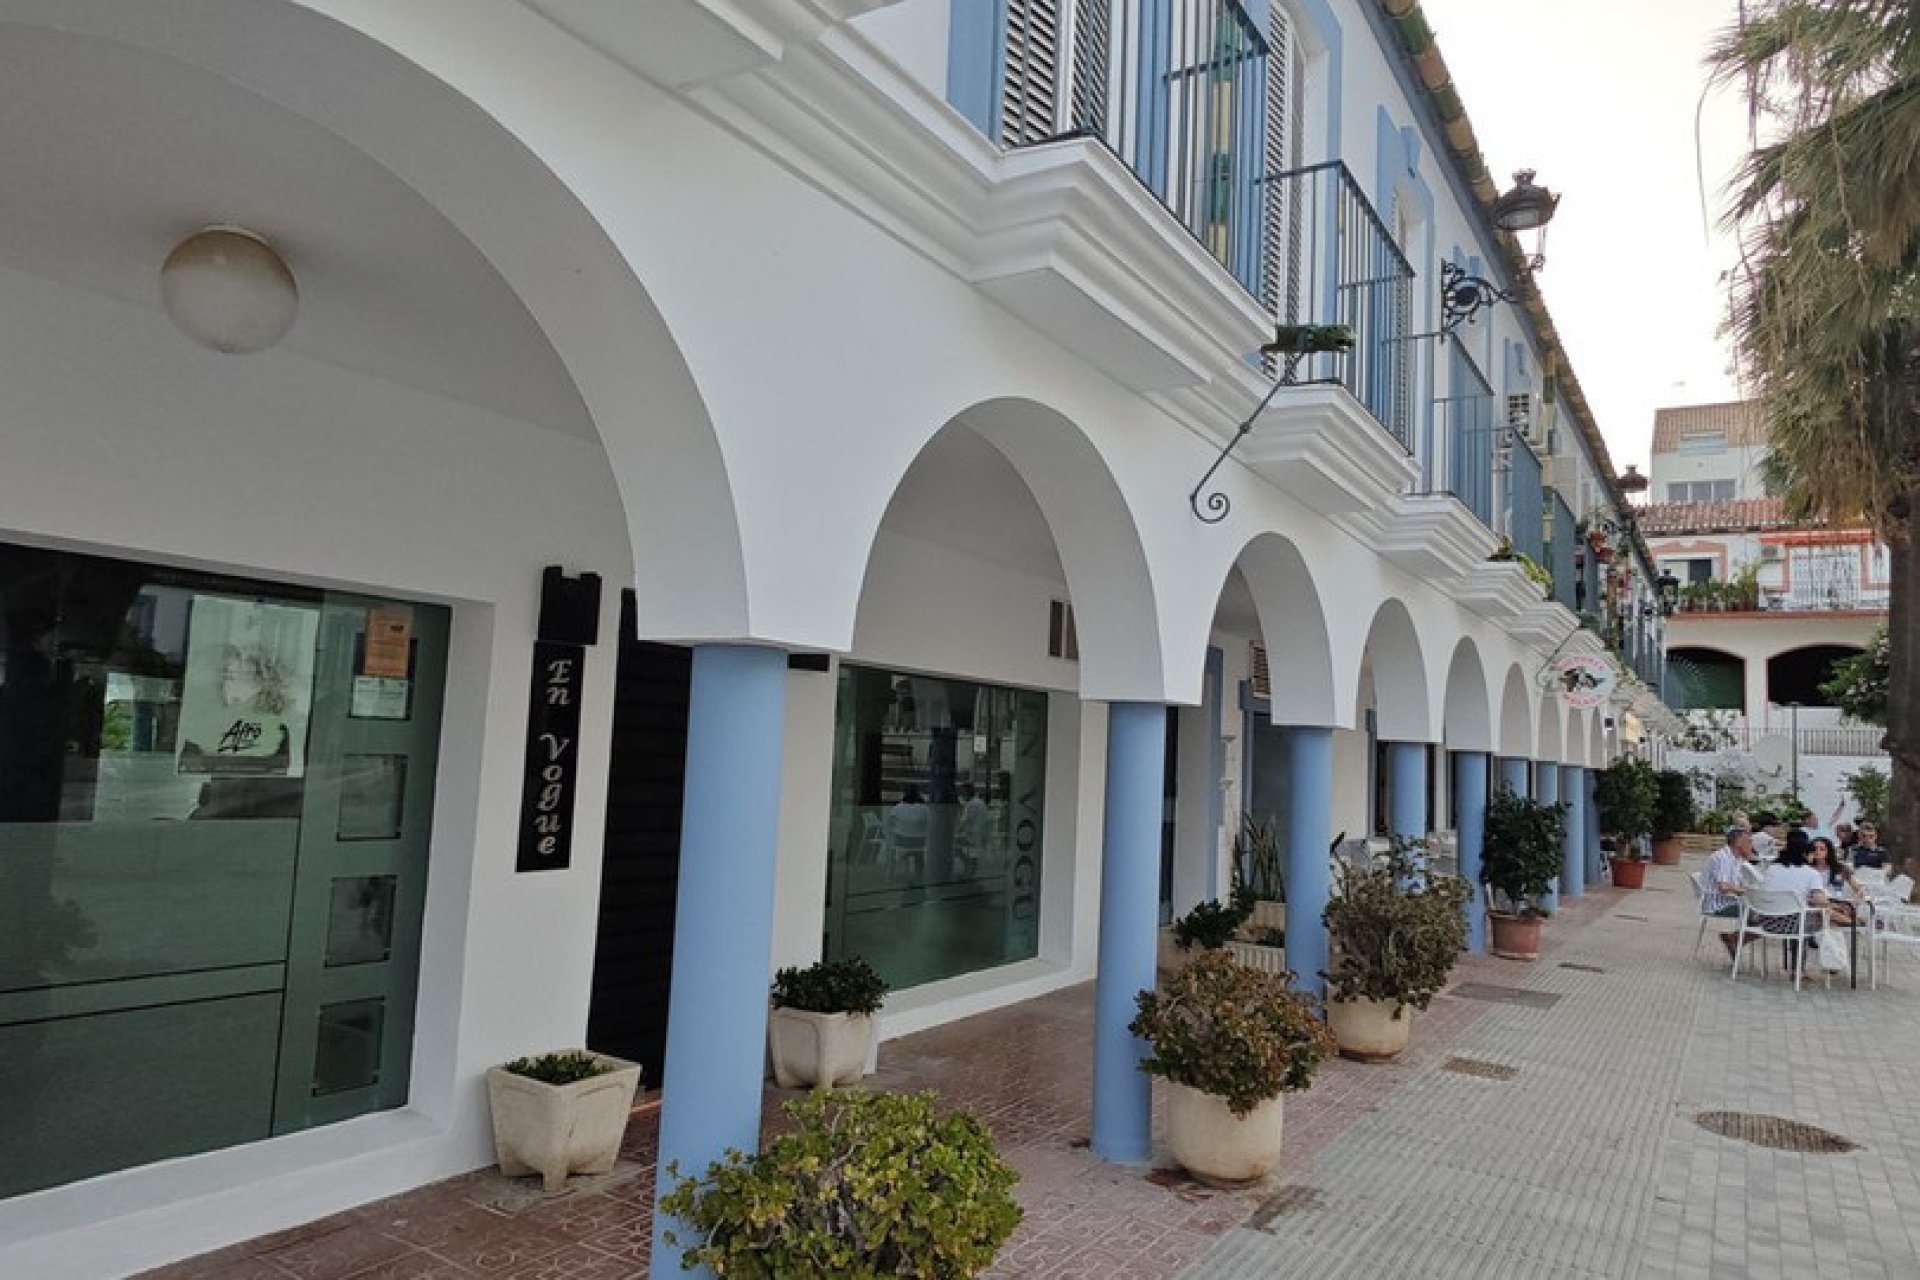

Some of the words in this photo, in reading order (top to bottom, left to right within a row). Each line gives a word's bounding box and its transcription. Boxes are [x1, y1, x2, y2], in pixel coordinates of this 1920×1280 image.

[547, 659, 573, 705] En
[534, 734, 570, 854] Vogue
[1012, 787, 1038, 924] VOGU
